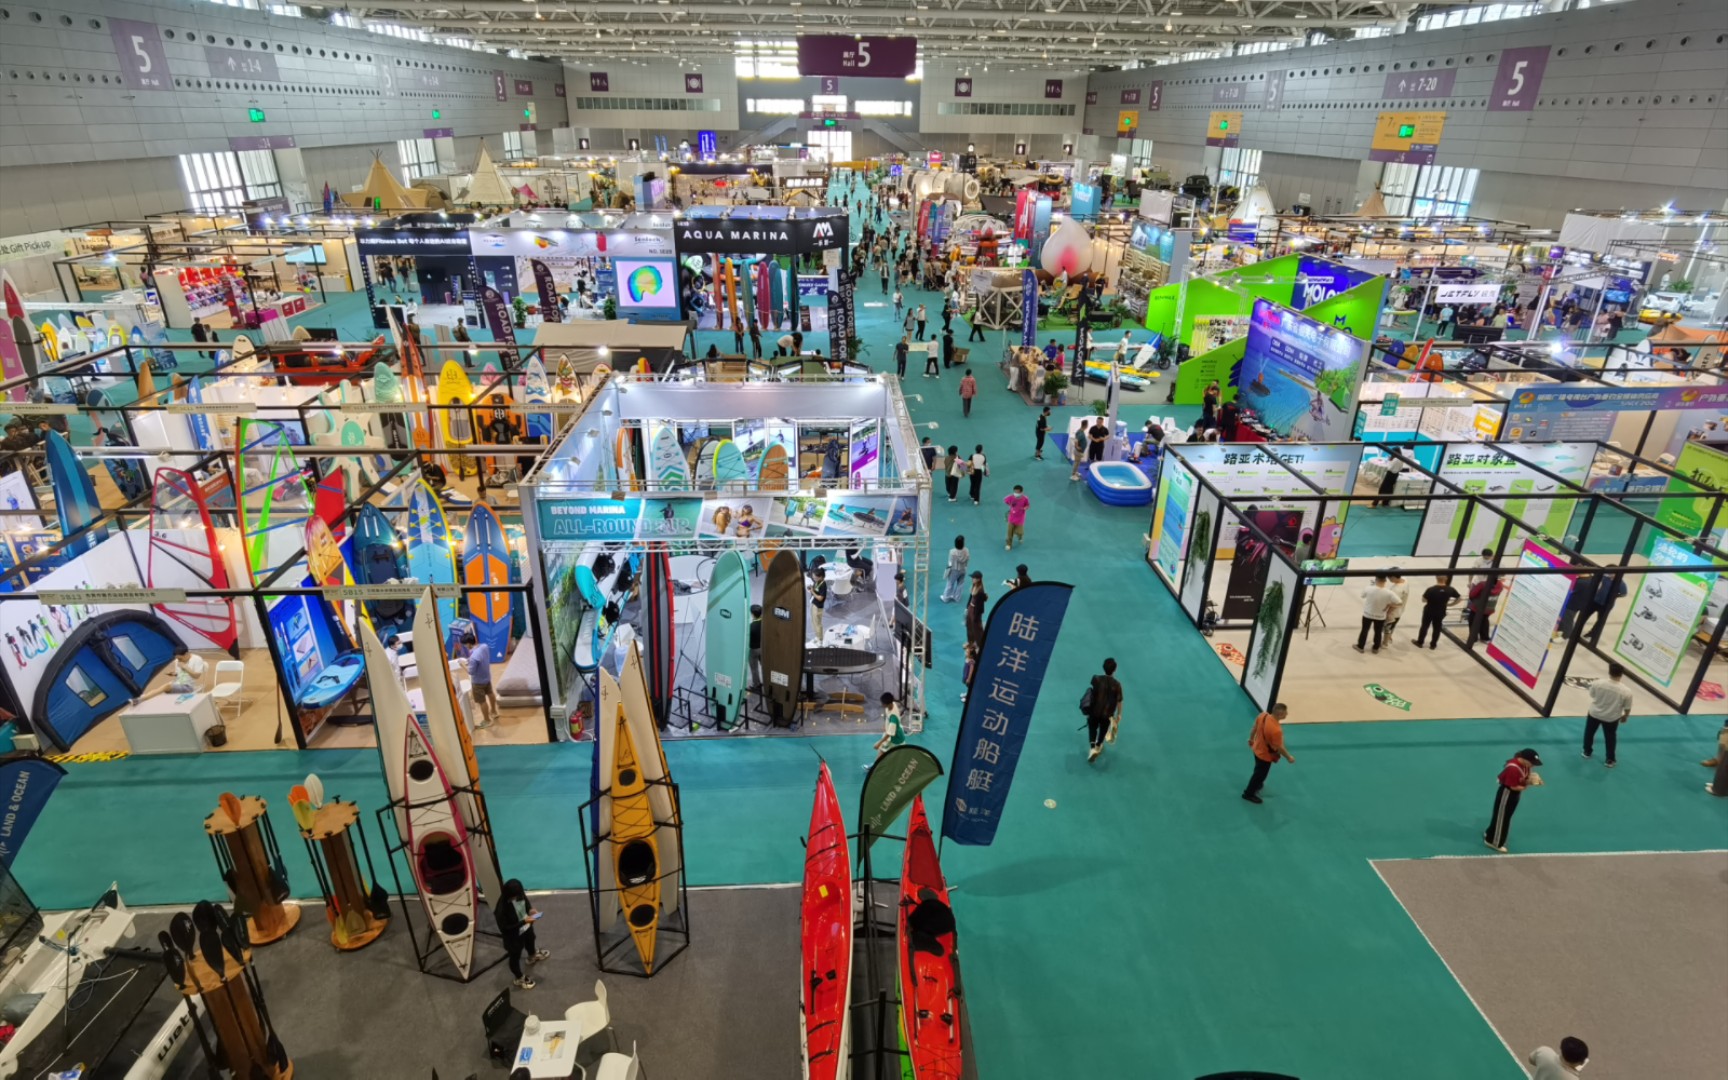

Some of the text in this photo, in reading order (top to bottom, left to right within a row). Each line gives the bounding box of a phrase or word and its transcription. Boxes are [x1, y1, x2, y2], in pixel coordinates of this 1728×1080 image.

[131, 36, 152, 72] 5
[858, 42, 870, 67] 5
[497, 76, 502, 94] 5
[826, 80, 833, 91] 5
[1268, 78, 1278, 102] 5
[1418, 77, 1438, 92] 7-20
[1508, 60, 1528, 96] 5
[1153, 86, 1158, 104] 5
[10, 243, 24, 254] Gift
[24, 240, 51, 251] Pick-up
[683, 230, 788, 241] AQUA MARINA
[544, 276, 556, 305] ROAD
[496, 303, 512, 334] ROAD
[837, 308, 846, 337] ROAD
[1075, 328, 1084, 377] MOLOKAI
[551, 505, 626, 515] BEYOND MARINA
[554, 518, 650, 535] ALL-ROUND
[966, 612, 1040, 792] 陆洋运动船艇
[880, 791, 897, 812] LAND
[898, 758, 918, 784] OCEAN
[0, 812, 16, 837] LAND
[12, 770, 30, 802] OCEAN
